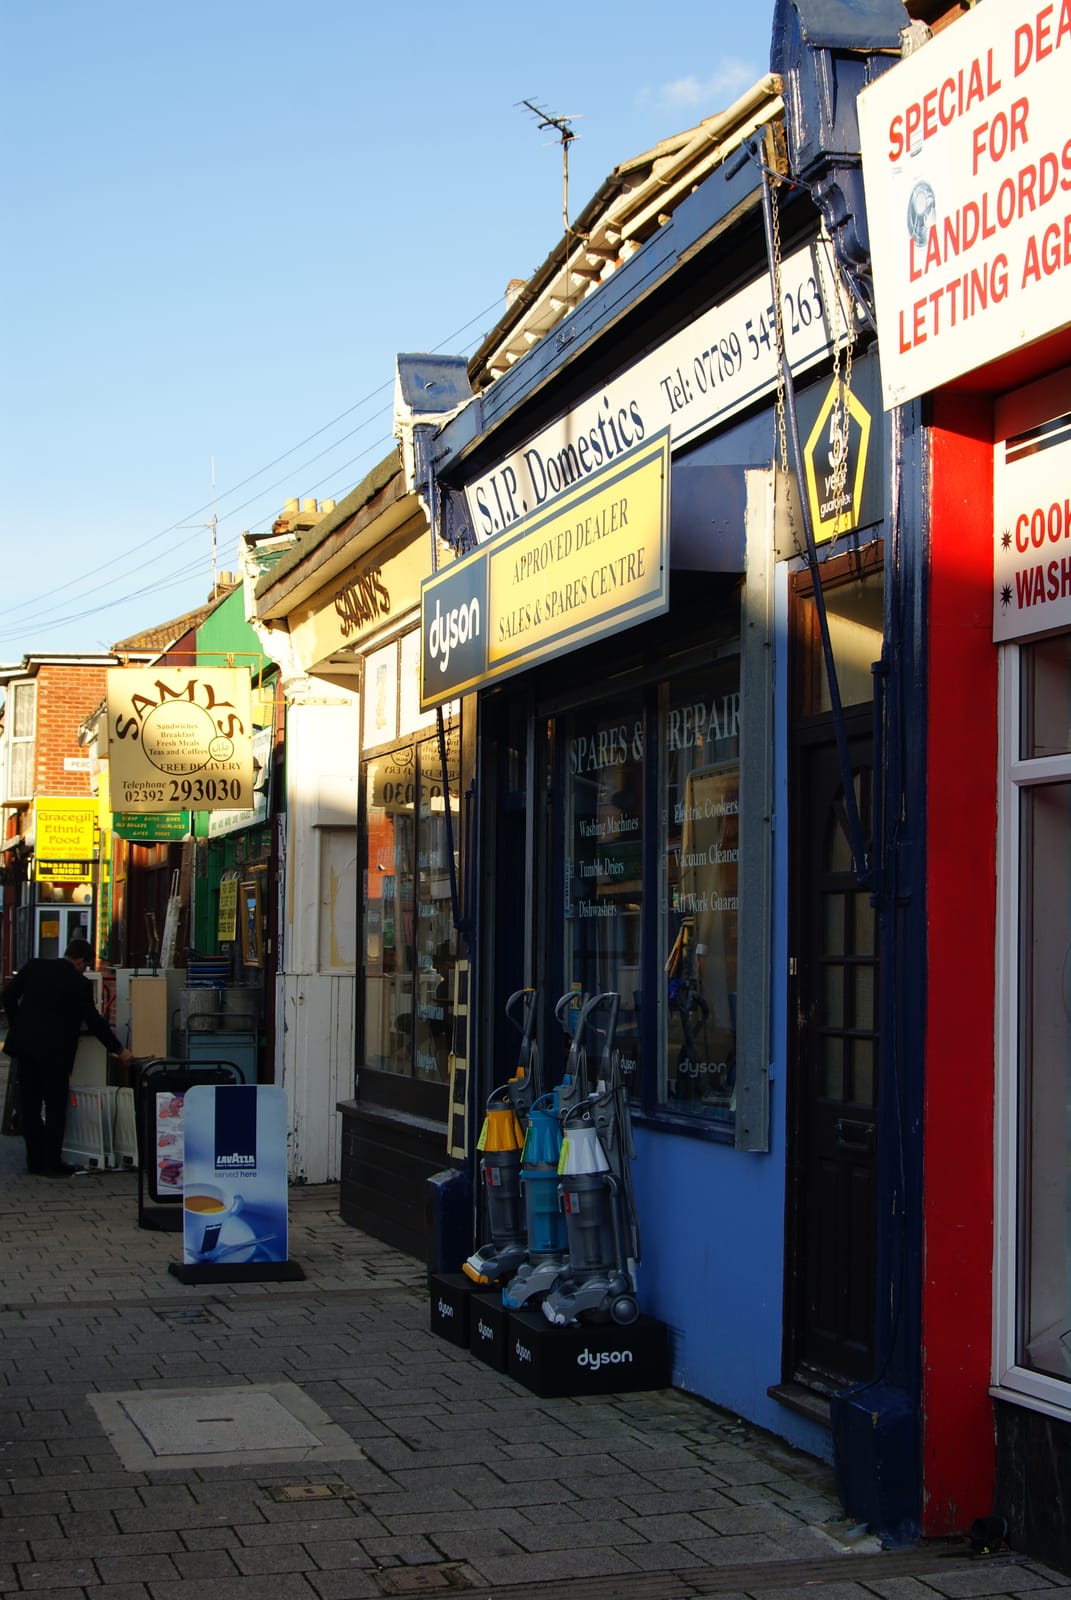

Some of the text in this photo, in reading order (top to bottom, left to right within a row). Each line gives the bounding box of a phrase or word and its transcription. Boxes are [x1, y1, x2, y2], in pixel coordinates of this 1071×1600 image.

[888, 48, 1001, 162] SPECIAL
[973, 97, 1029, 176] FOR
[899, 253, 1008, 355] LETTING
[660, 370, 694, 414] Tel:
[693, 331, 743, 393] 07789
[784, 277, 823, 335] 263
[827, 411, 844, 468] 5
[476, 396, 645, 535] S.I.P. Domestics
[513, 498, 628, 585] APPROVED DEALER
[1015, 556, 1071, 610] WASH
[499, 546, 645, 642] SALES & SPARES CENTRE
[429, 597, 480, 672] dyson
[156, 722, 199, 730] Sandwiches
[160, 731, 195, 739] Breakfast
[568, 691, 741, 776] SPARES & REPAIR
[181, 748, 208, 756] Coffees
[159, 762, 242, 772] FREE DELIVERY
[122, 780, 167, 790] Telephone
[124, 778, 242, 802] 02392 293030
[704, 798, 739, 819] Cookers
[45, 825, 86, 834] Ethnic
[579, 814, 639, 838] Washing Machines
[49, 835, 80, 845] Food
[579, 857, 625, 878] Tumble Driers
[674, 849, 707, 868] Vacuum
[578, 898, 617, 918] Dishwashers
[686, 893, 708, 912] Work
[620, 1053, 637, 1074] dyson
[678, 1058, 728, 1078] dyson
[215, 1152, 255, 1164] LAVAZZA
[214, 1170, 257, 1178] served here
[437, 1298, 454, 1319] dyson
[478, 1318, 494, 1340] dyson
[515, 1338, 532, 1363] dyson
[576, 1347, 633, 1371] dyson
